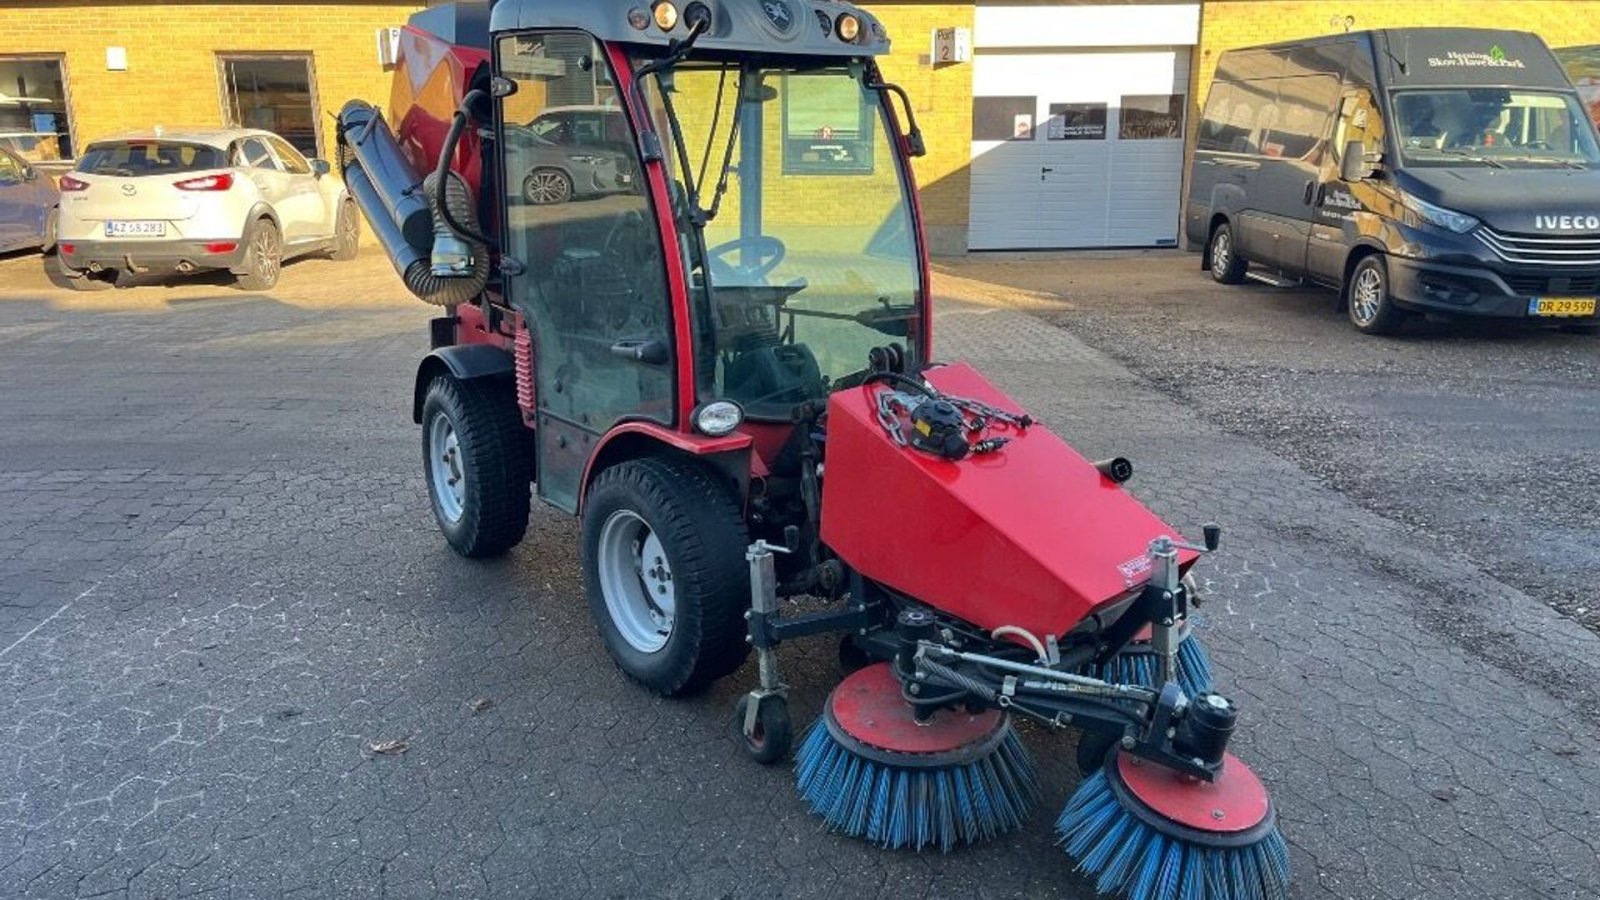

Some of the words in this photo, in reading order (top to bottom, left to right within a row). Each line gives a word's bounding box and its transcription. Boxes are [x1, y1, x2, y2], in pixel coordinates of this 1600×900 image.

[942, 45, 950, 60] 2
[1536, 215, 1599, 229] IVECO
[1538, 301, 1554, 312] DR
